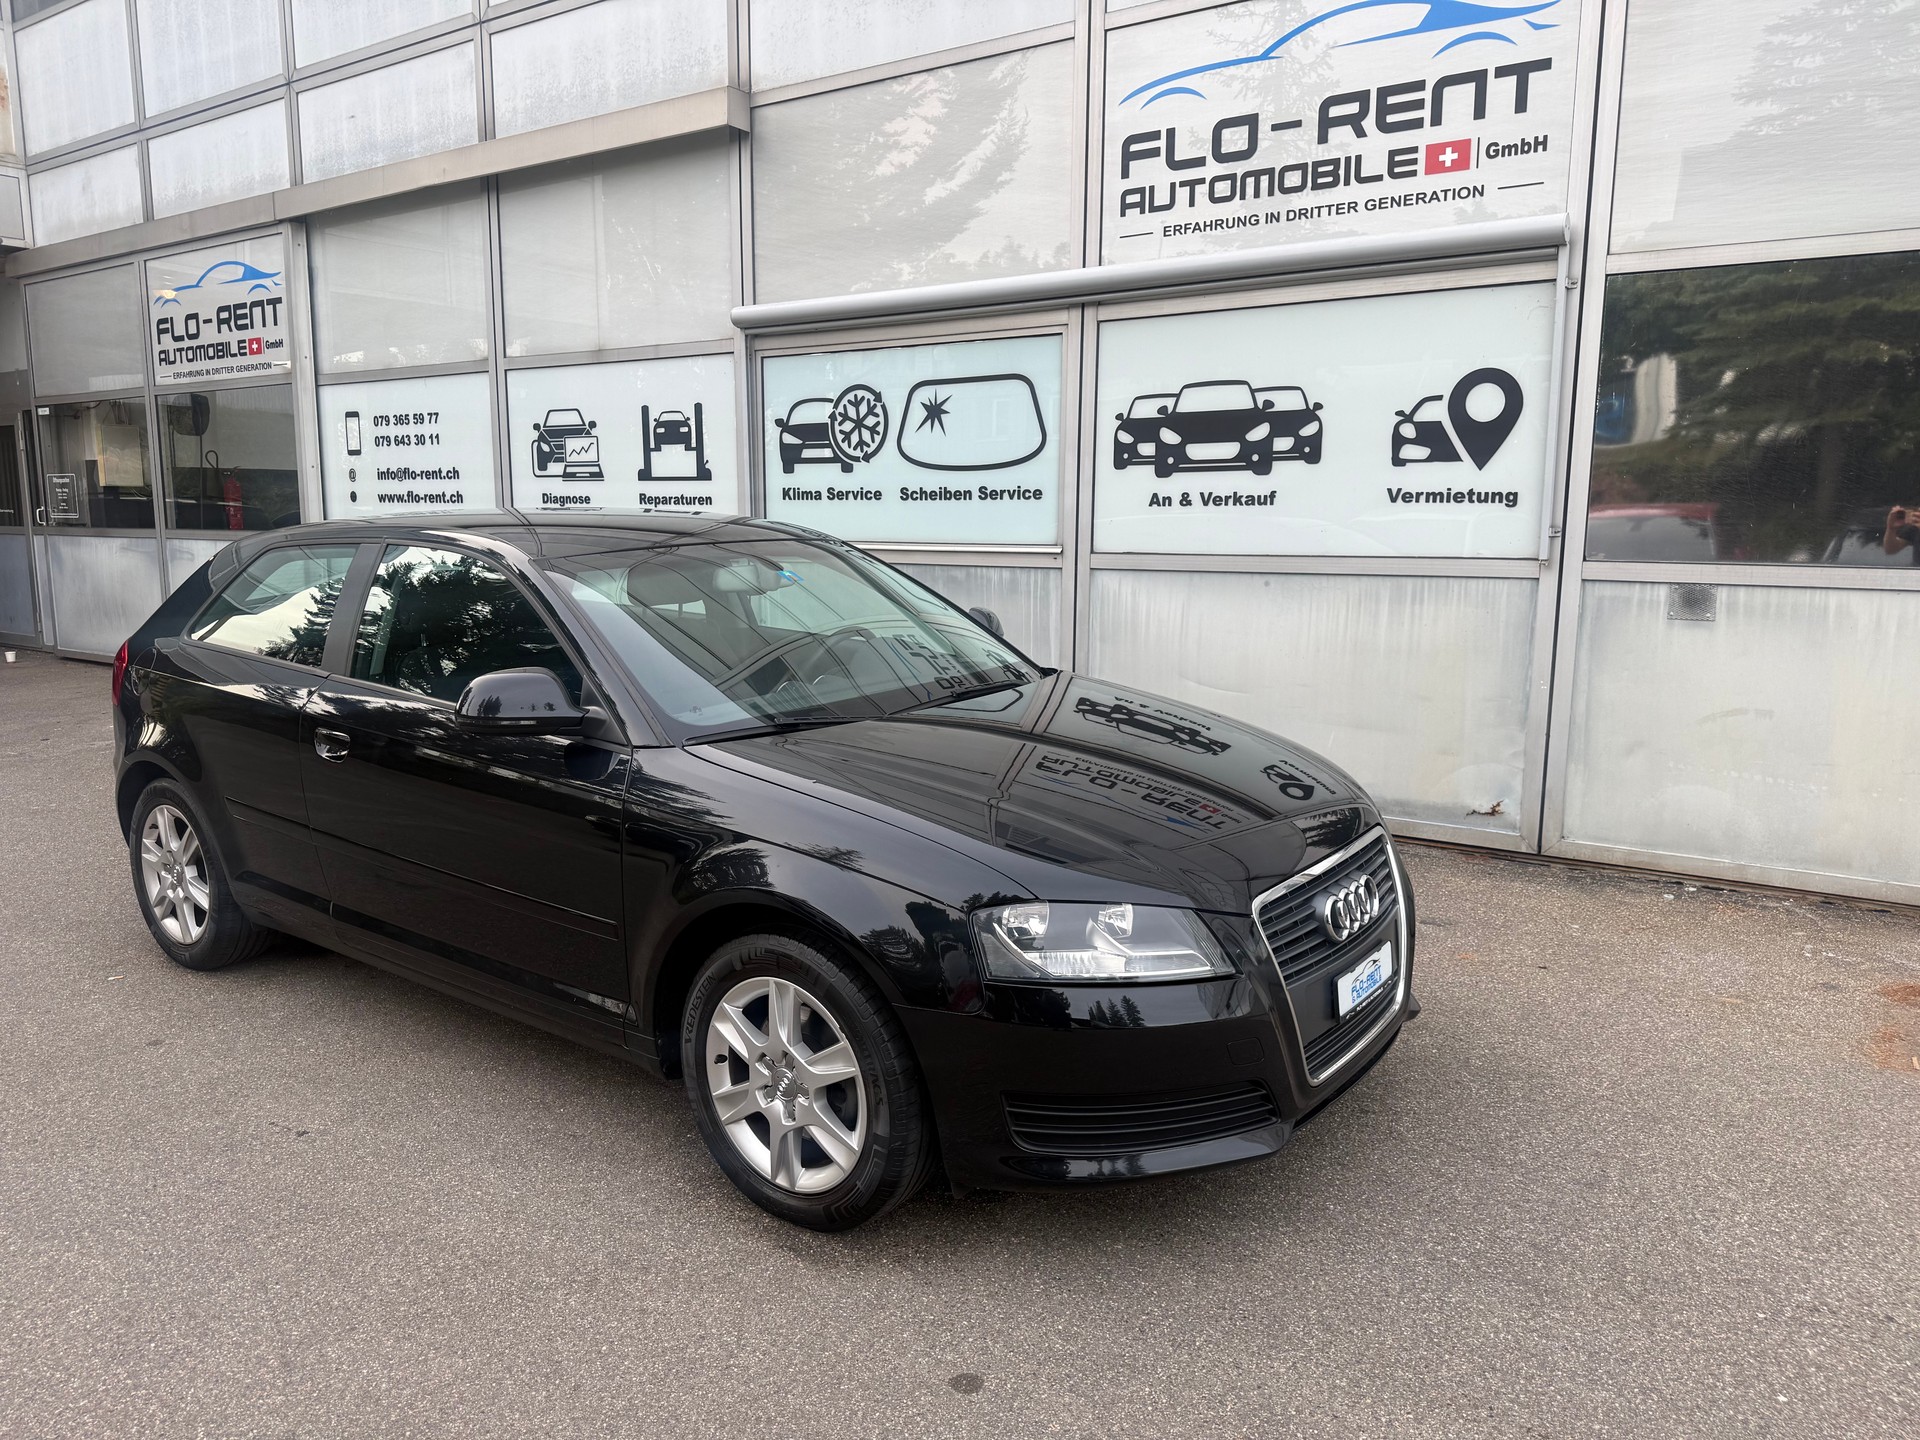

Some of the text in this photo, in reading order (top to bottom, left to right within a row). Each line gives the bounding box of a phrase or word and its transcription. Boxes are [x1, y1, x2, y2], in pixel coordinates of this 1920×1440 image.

[1120, 57, 1553, 180] FLO-RENT
[1119, 134, 1549, 218] AUTOMOBILE GmbH
[1163, 184, 1486, 238] ERFAHRUNG IN DRITTER GENERATION
[156, 296, 283, 345] FLO-RENT
[158, 338, 284, 366] AUTOMOBILE GmbH
[172, 369, 205, 380] ERFAHRUNG
[211, 366, 235, 375] DRITTER
[235, 361, 272, 373] GENERATION
[373, 411, 440, 427] 079 365 59 77
[374, 433, 440, 448] 079 643 30 11
[376, 466, 460, 483] info@flo-rent.ch
[377, 490, 464, 504] www.flo-rent.ch
[541, 492, 591, 507] Diagnose
[638, 492, 713, 508] Reparaturen
[782, 486, 883, 501] Klima Service
[899, 485, 1043, 501] Scheiben Service
[1148, 490, 1277, 507] An & Verkauf
[1386, 487, 1519, 508] Vermietung
[684, 971, 717, 1043] VREDESTEIN
